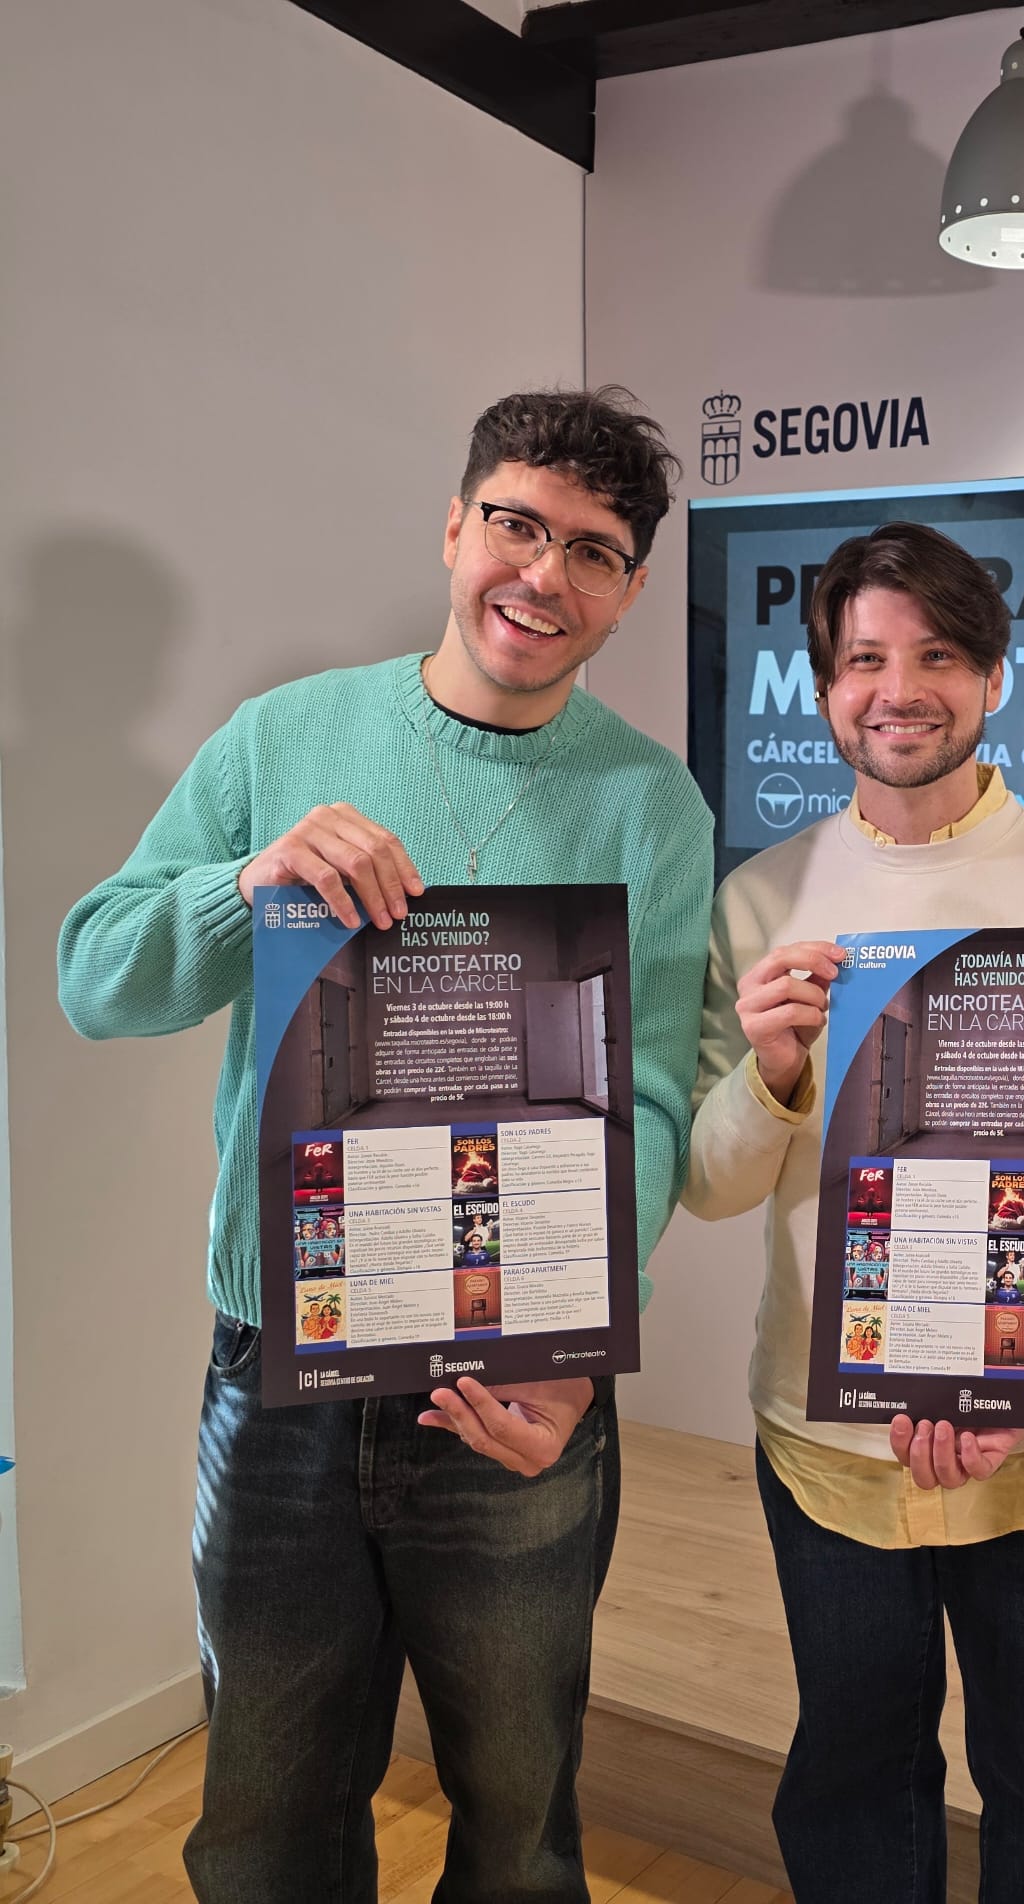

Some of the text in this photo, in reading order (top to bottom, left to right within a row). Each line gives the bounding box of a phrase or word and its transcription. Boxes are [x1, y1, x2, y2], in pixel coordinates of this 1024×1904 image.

[753, 396, 929, 458] SEGOVIA
[747, 732, 839, 764] CÁRCEL
[400, 909, 490, 931] ¿TODAVÍA NO
[402, 931, 490, 946] HAS VENIDO?
[860, 945, 916, 959] SEGOVIA
[372, 954, 521, 973] MICROTEATRO
[954, 951, 1012, 971] ¿TODAVÍA
[373, 969, 522, 994] EN LA CÁRCEL
[954, 972, 978, 986] HAS
[386, 1003, 410, 1012] Viernes
[418, 1002, 426, 1011] de
[428, 1002, 452, 1010] octubre
[454, 1001, 473, 1010] desde
[474, 1001, 483, 1009] las
[486, 1001, 502, 1009] 19:00
[504, 1000, 508, 1008] h
[384, 1017, 388, 1025] y
[390, 1015, 413, 1023] sábado
[431, 1014, 455, 1022] octubre
[457, 1013, 476, 1022] desde
[477, 1013, 486, 1021] las
[488, 1012, 505, 1020] 18:00
[507, 1012, 511, 1020] h
[928, 1014, 952, 1031] EN
[960, 1014, 982, 1031] LA
[408, 1028, 439, 1037] disponibles
[938, 1040, 960, 1048] Viernes
[975, 1039, 997, 1048] octubre
[999, 1039, 1016, 1048] desde
[941, 1051, 961, 1059] sábado
[968, 1051, 975, 1059] de
[977, 1051, 999, 1059] octubre
[1000, 1051, 1018, 1059] desde
[408, 1067, 424, 1075] precio
[426, 1066, 433, 1074] de
[430, 1094, 447, 1102] precio
[528, 1128, 551, 1136] PADRES
[454, 1144, 495, 1153] PADRES
[349, 1209, 364, 1217] UNA
[366, 1206, 405, 1216] HABITACIÓN
[454, 1202, 498, 1216] EL ESCUDO
[988, 1240, 998, 1251] EL
[531, 1265, 568, 1274] APARTMENT
[567, 1350, 606, 1359] microteatro
[444, 1360, 485, 1373] SEGOVIA
[974, 1398, 1012, 1411] SEGOVIA
